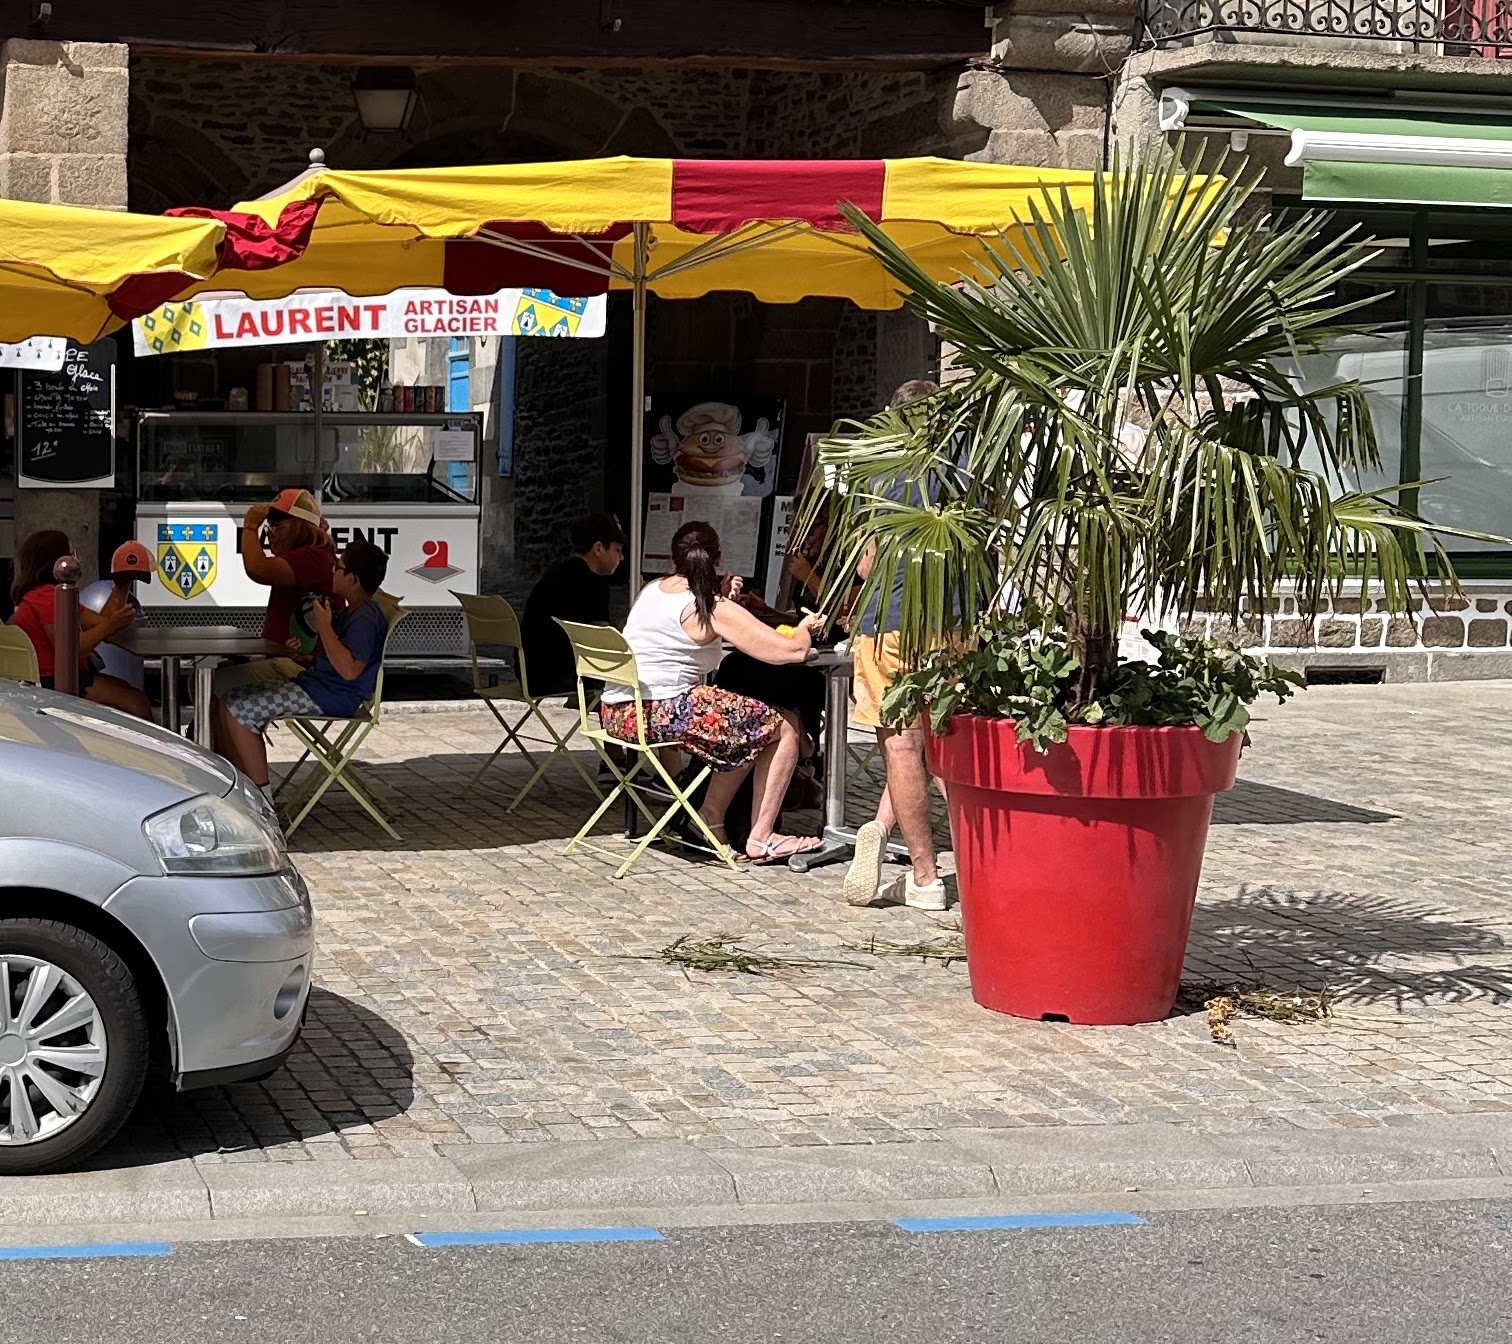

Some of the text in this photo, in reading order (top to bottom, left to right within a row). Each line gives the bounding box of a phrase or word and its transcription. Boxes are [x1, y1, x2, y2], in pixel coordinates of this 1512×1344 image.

[404, 299, 499, 316] ARTISAN
[214, 304, 387, 340] LAURENT
[404, 316, 498, 334] GLACIER
